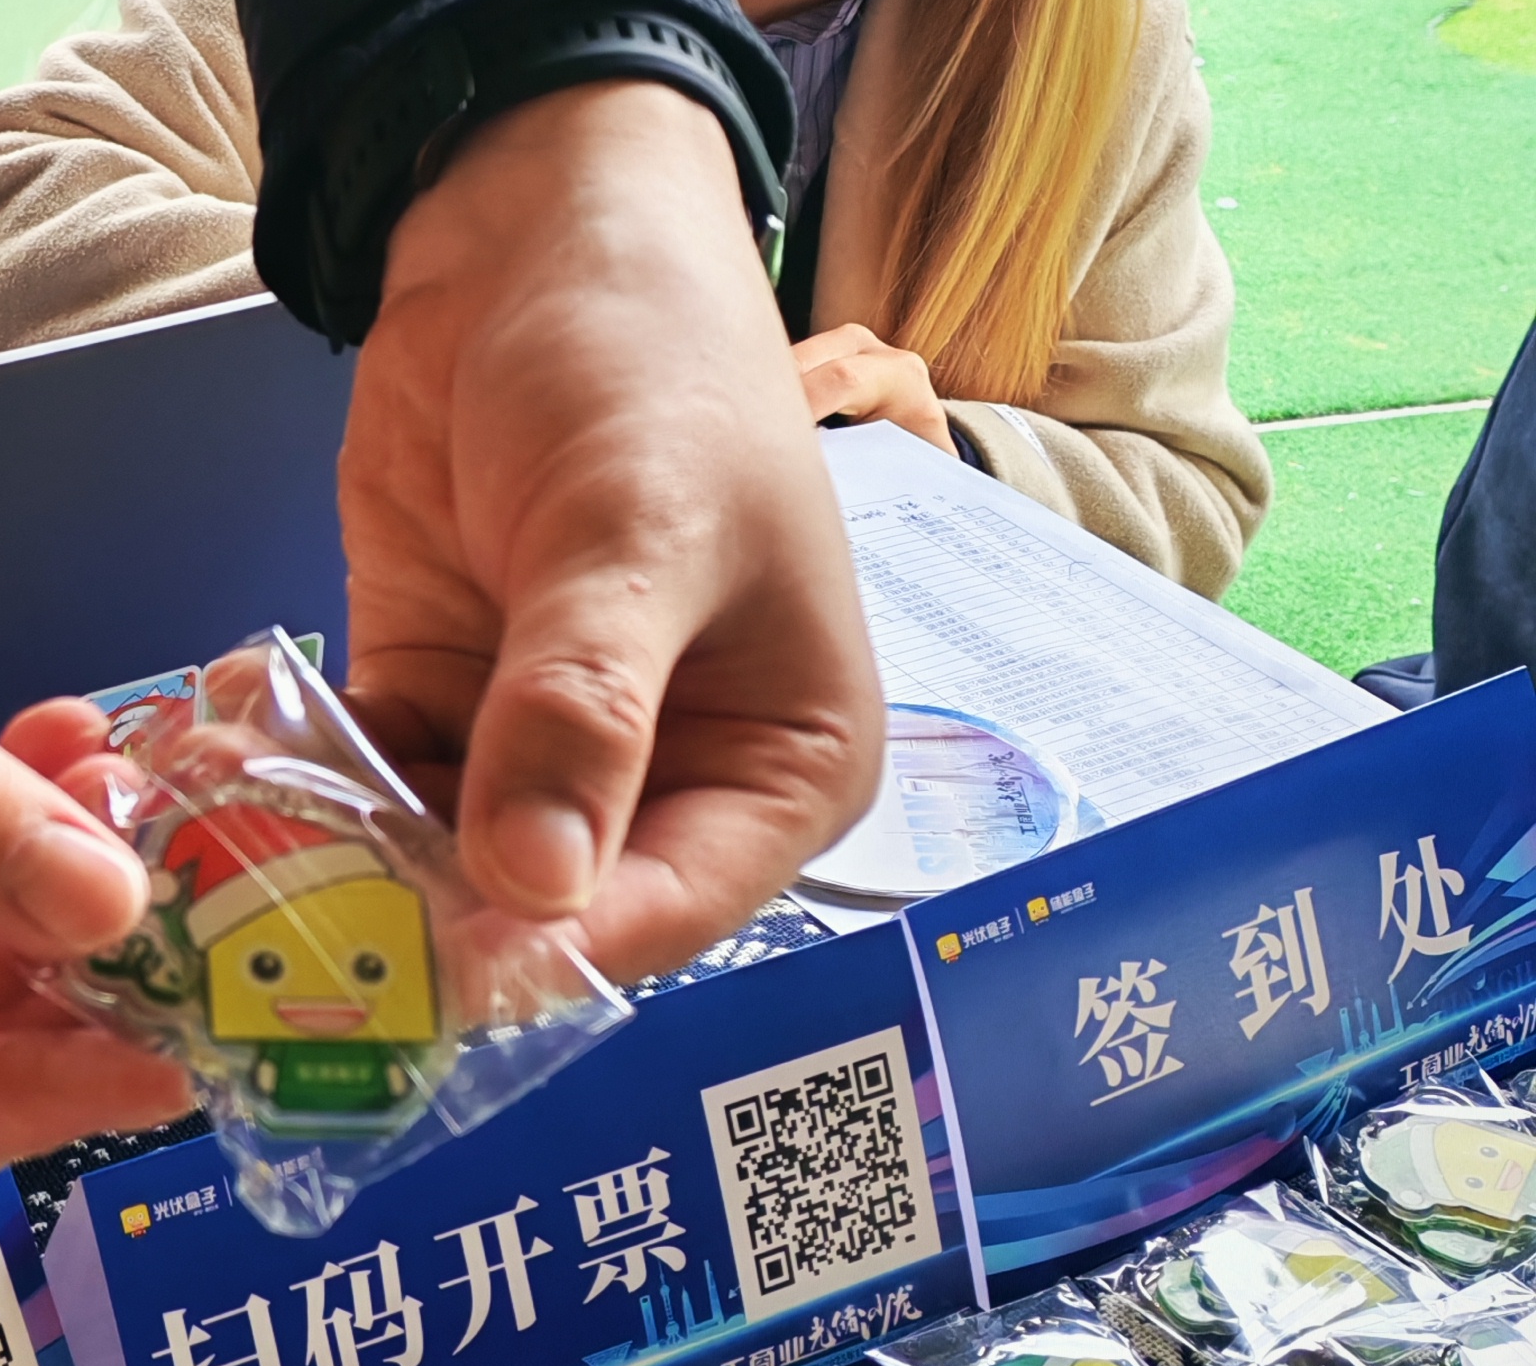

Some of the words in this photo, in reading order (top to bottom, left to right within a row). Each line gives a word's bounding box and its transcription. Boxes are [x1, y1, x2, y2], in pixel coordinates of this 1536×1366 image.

[962, 916, 1011, 949] 光伏盒子
[1073, 835, 1477, 1106] 签到处
[153, 1185, 218, 1222] 光伏盒子
